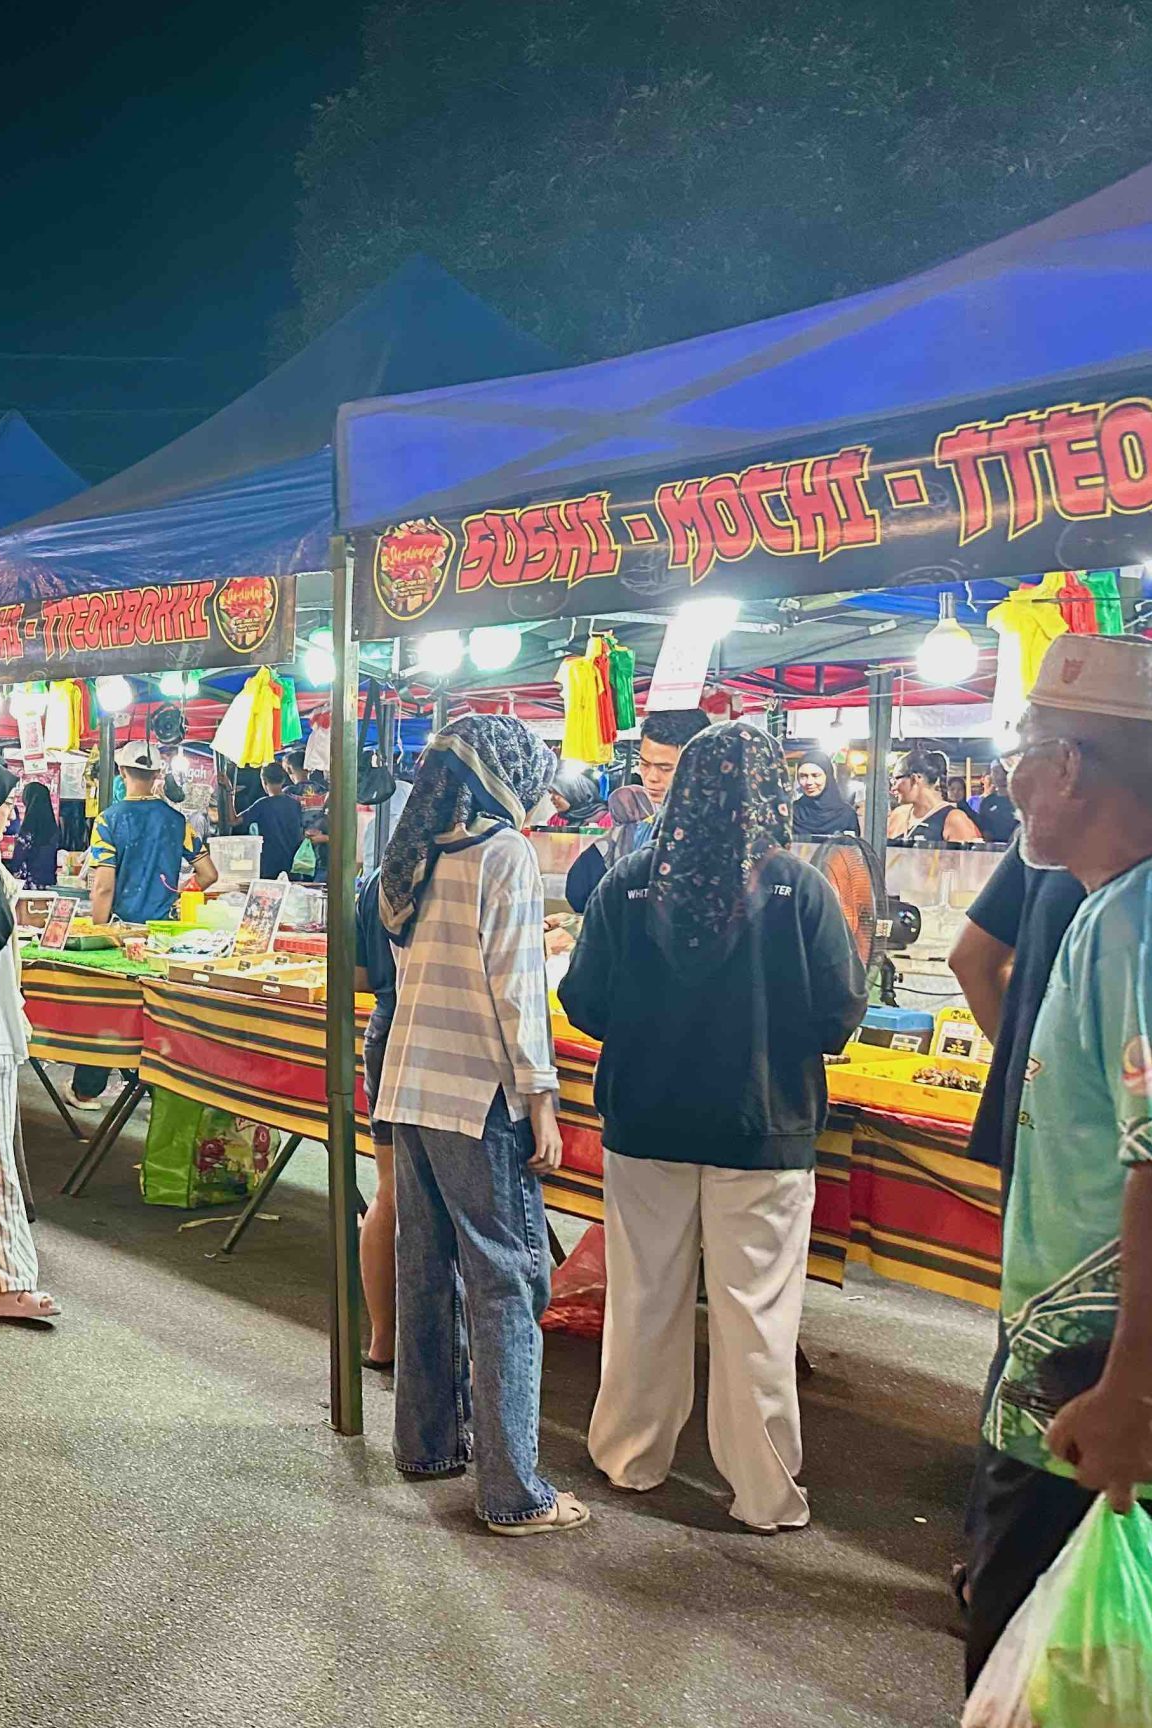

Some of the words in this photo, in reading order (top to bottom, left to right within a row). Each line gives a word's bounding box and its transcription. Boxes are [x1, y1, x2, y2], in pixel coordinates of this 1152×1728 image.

[456, 491, 621, 593] SUSHI
[655, 445, 881, 586] MOCHI
[627, 888, 649, 900] WHIT
[769, 884, 792, 897] TER
